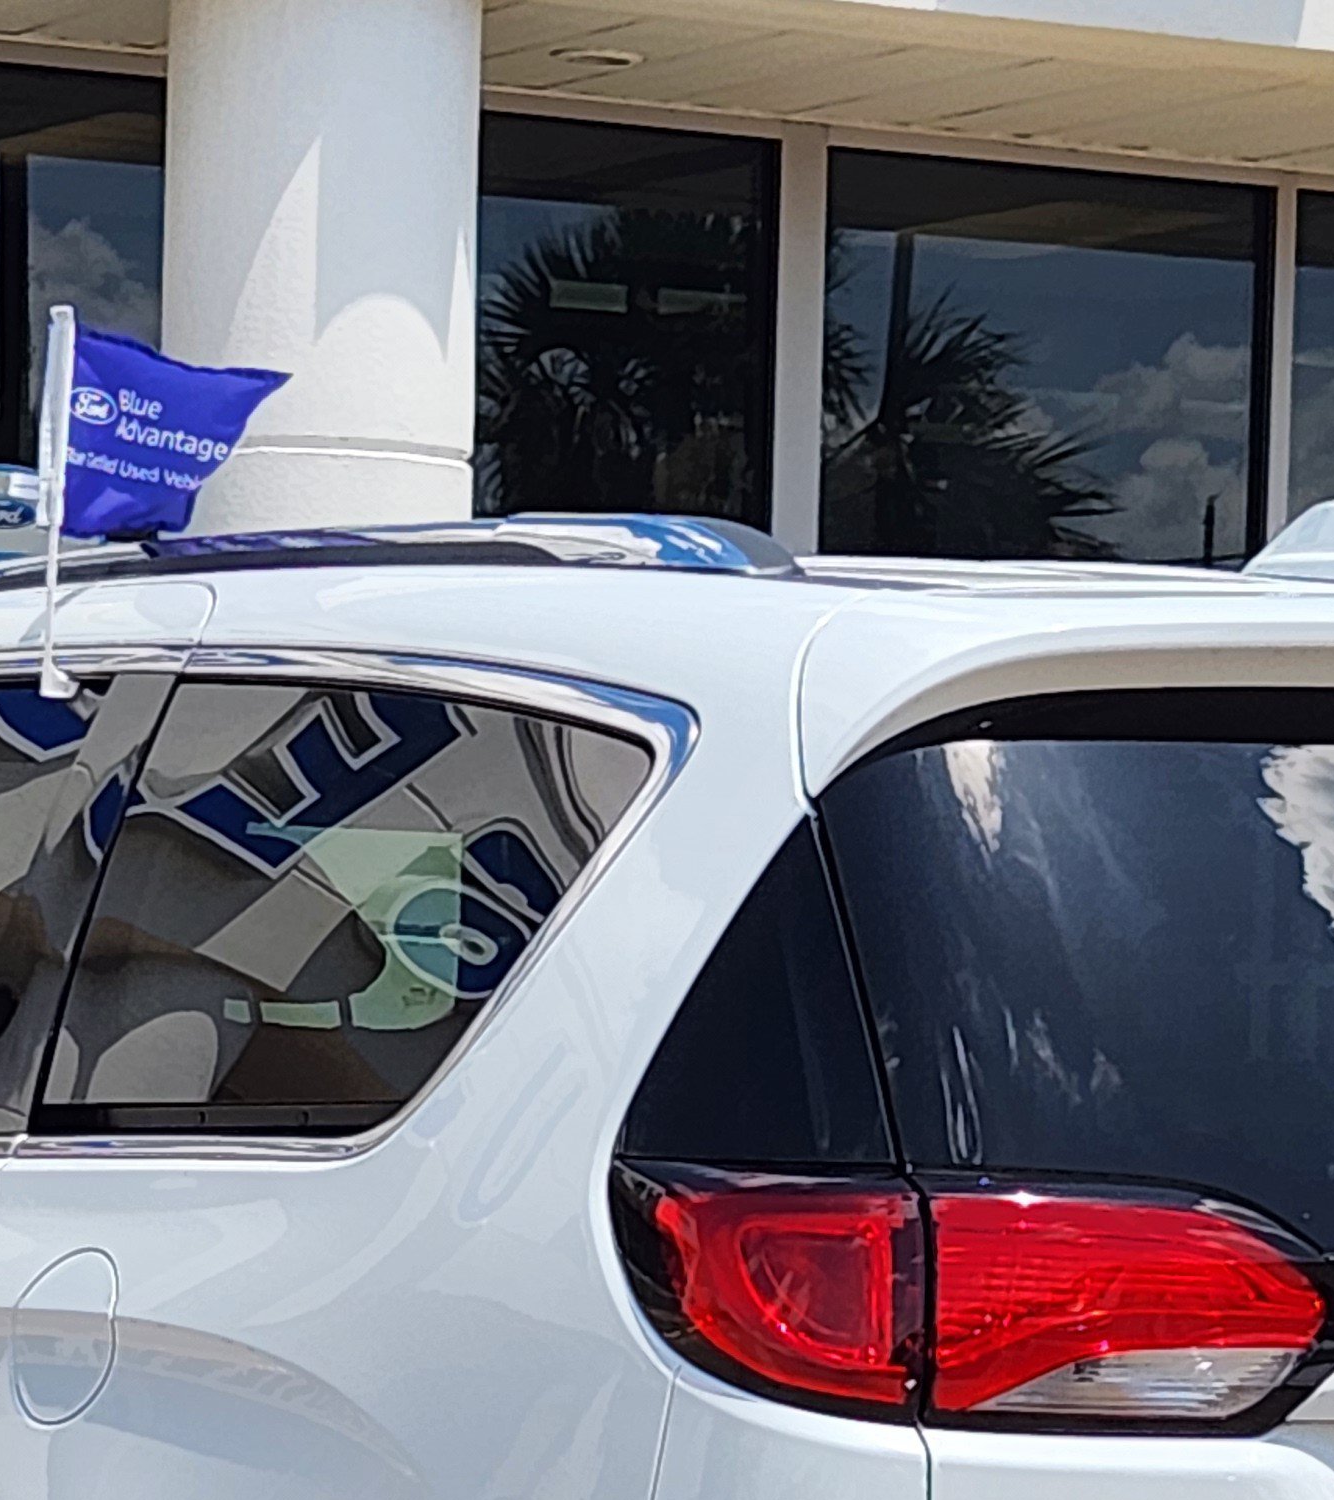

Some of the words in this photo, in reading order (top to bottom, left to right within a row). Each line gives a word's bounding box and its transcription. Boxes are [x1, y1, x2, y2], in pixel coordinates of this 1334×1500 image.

[74, 393, 110, 421] Ford
[118, 388, 164, 421] Blue
[115, 416, 229, 463] Advantage
